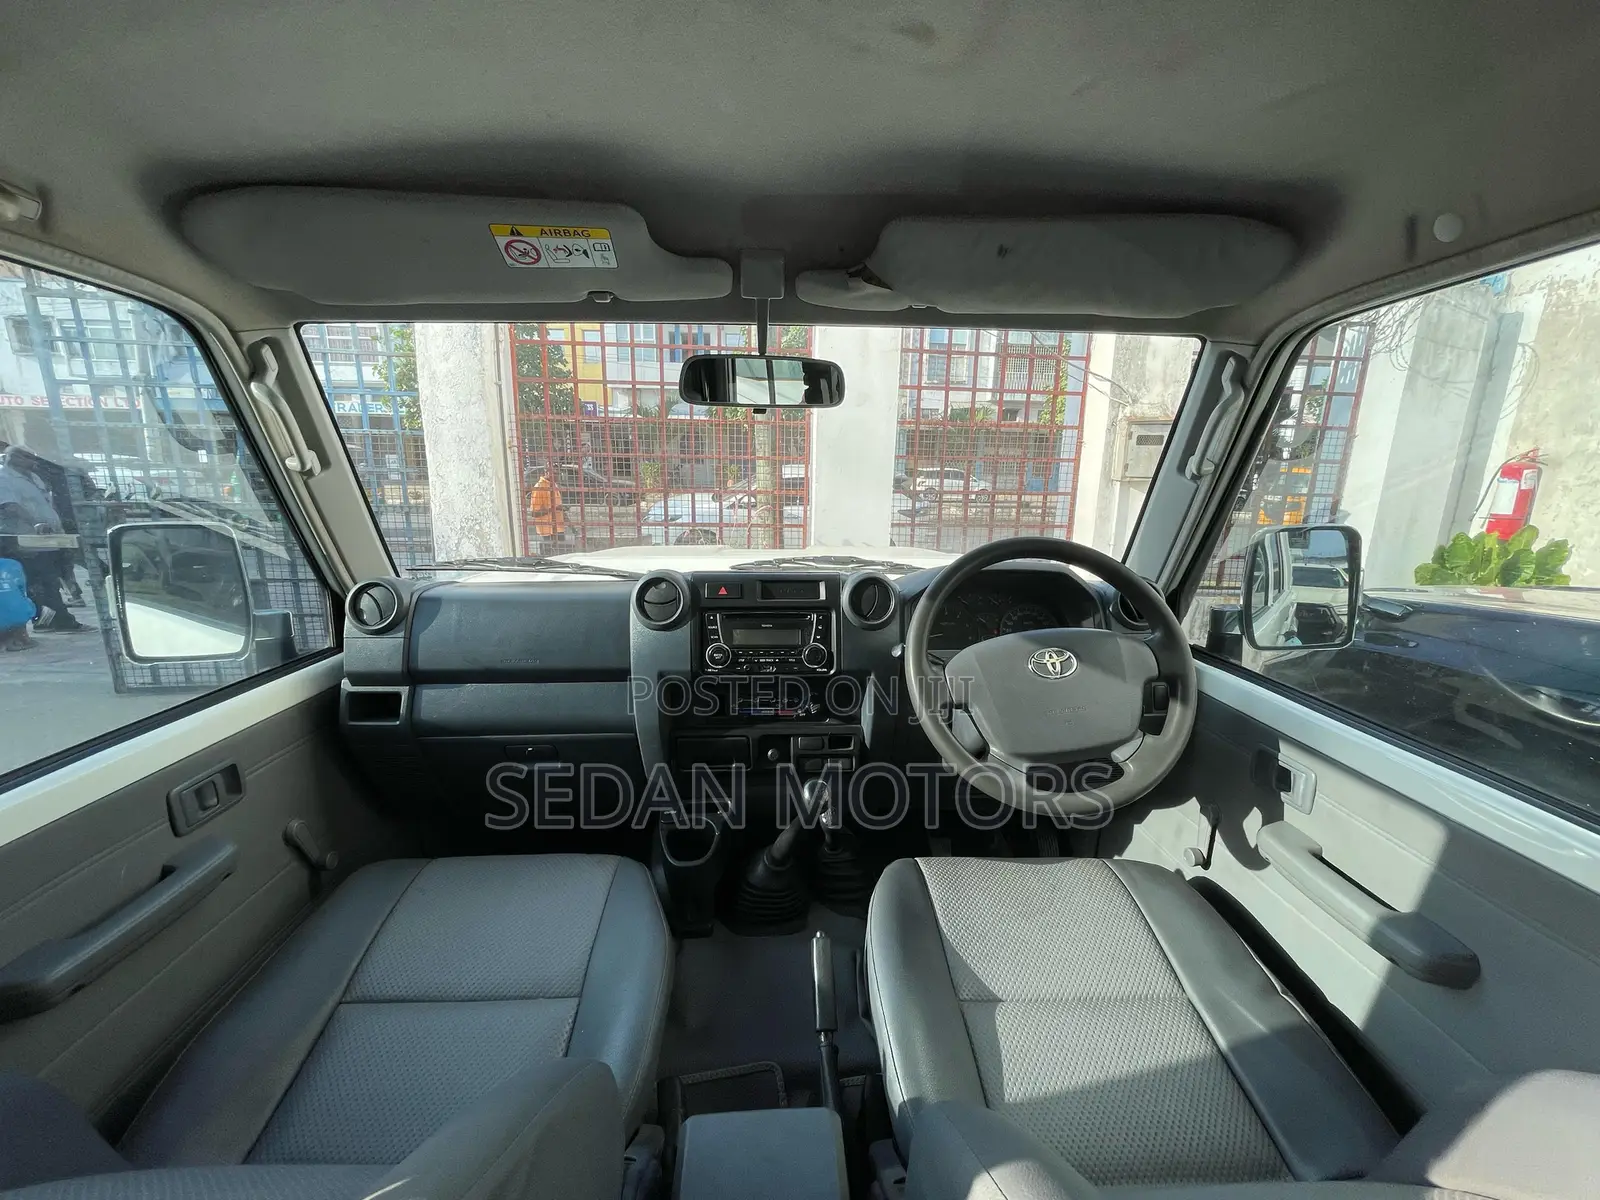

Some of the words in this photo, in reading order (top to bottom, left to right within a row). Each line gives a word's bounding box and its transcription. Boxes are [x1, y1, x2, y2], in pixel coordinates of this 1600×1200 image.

[540, 228, 591, 238] AIRBAG
[31, 395, 109, 408] SEECTION
[332, 401, 392, 413] RAERS
